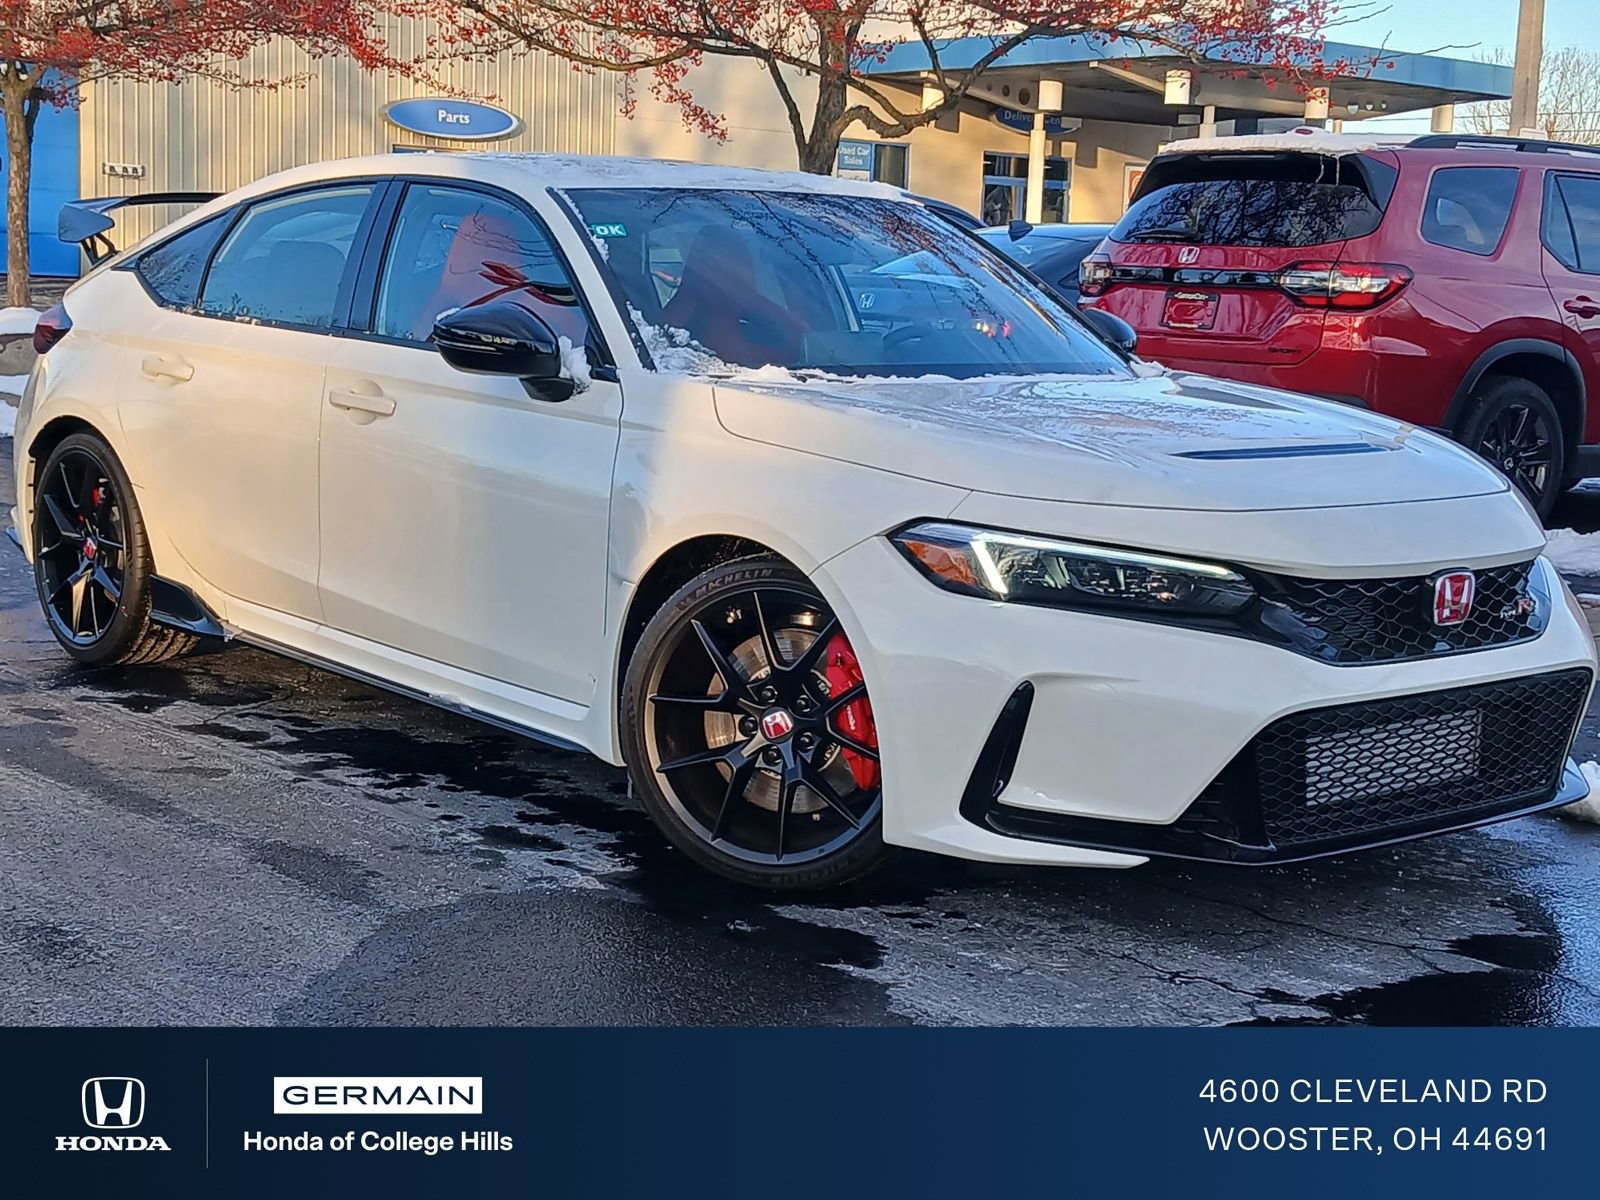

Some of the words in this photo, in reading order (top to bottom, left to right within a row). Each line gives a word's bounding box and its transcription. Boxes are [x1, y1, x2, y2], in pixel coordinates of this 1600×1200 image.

[438, 109, 470, 124] Parts
[856, 146, 870, 156] Car
[843, 156, 863, 165] Sales
[595, 225, 626, 236] OK
